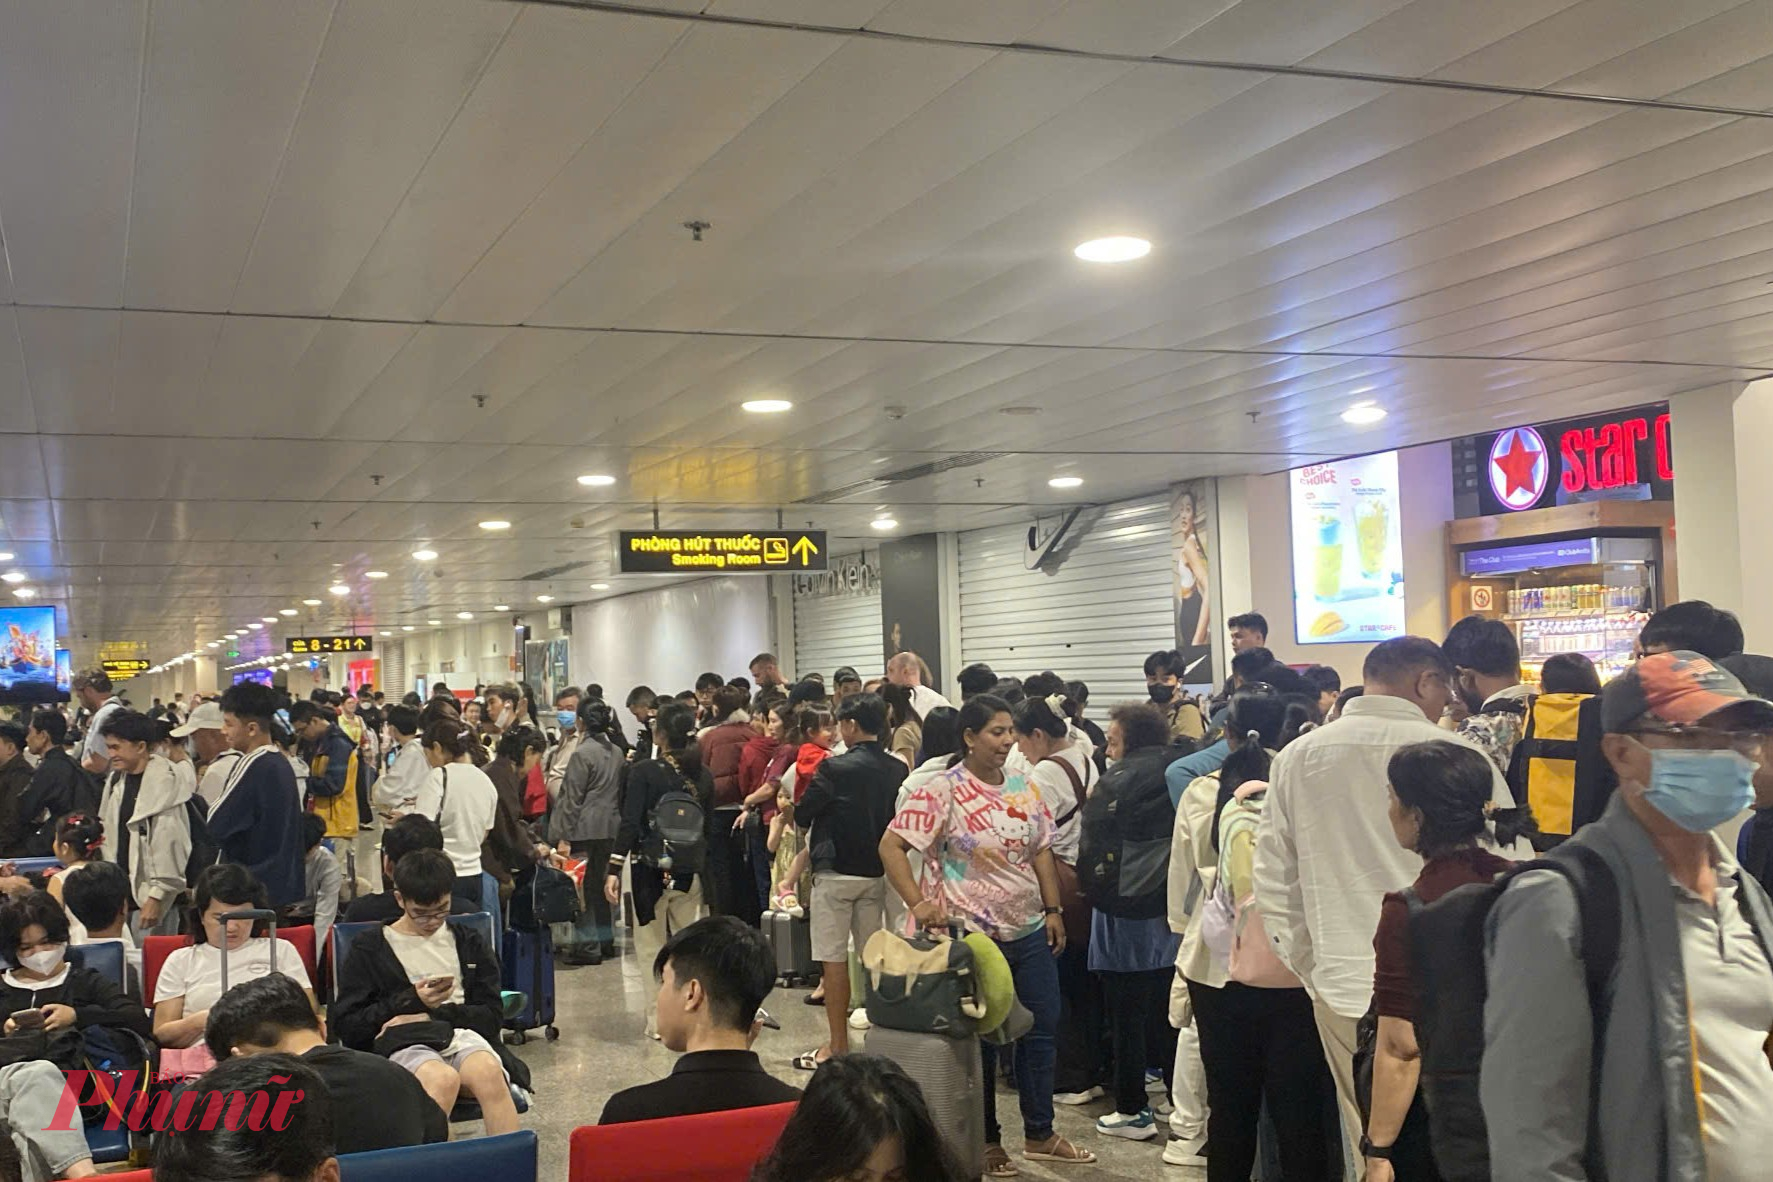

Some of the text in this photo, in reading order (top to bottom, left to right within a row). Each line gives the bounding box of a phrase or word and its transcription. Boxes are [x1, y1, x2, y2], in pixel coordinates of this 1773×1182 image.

[631, 534, 760, 551] PHÒNG HÚT THUỐC
[672, 553, 761, 567] Smoking Room
[311, 639, 320, 651] 8
[333, 638, 350, 651] 21
